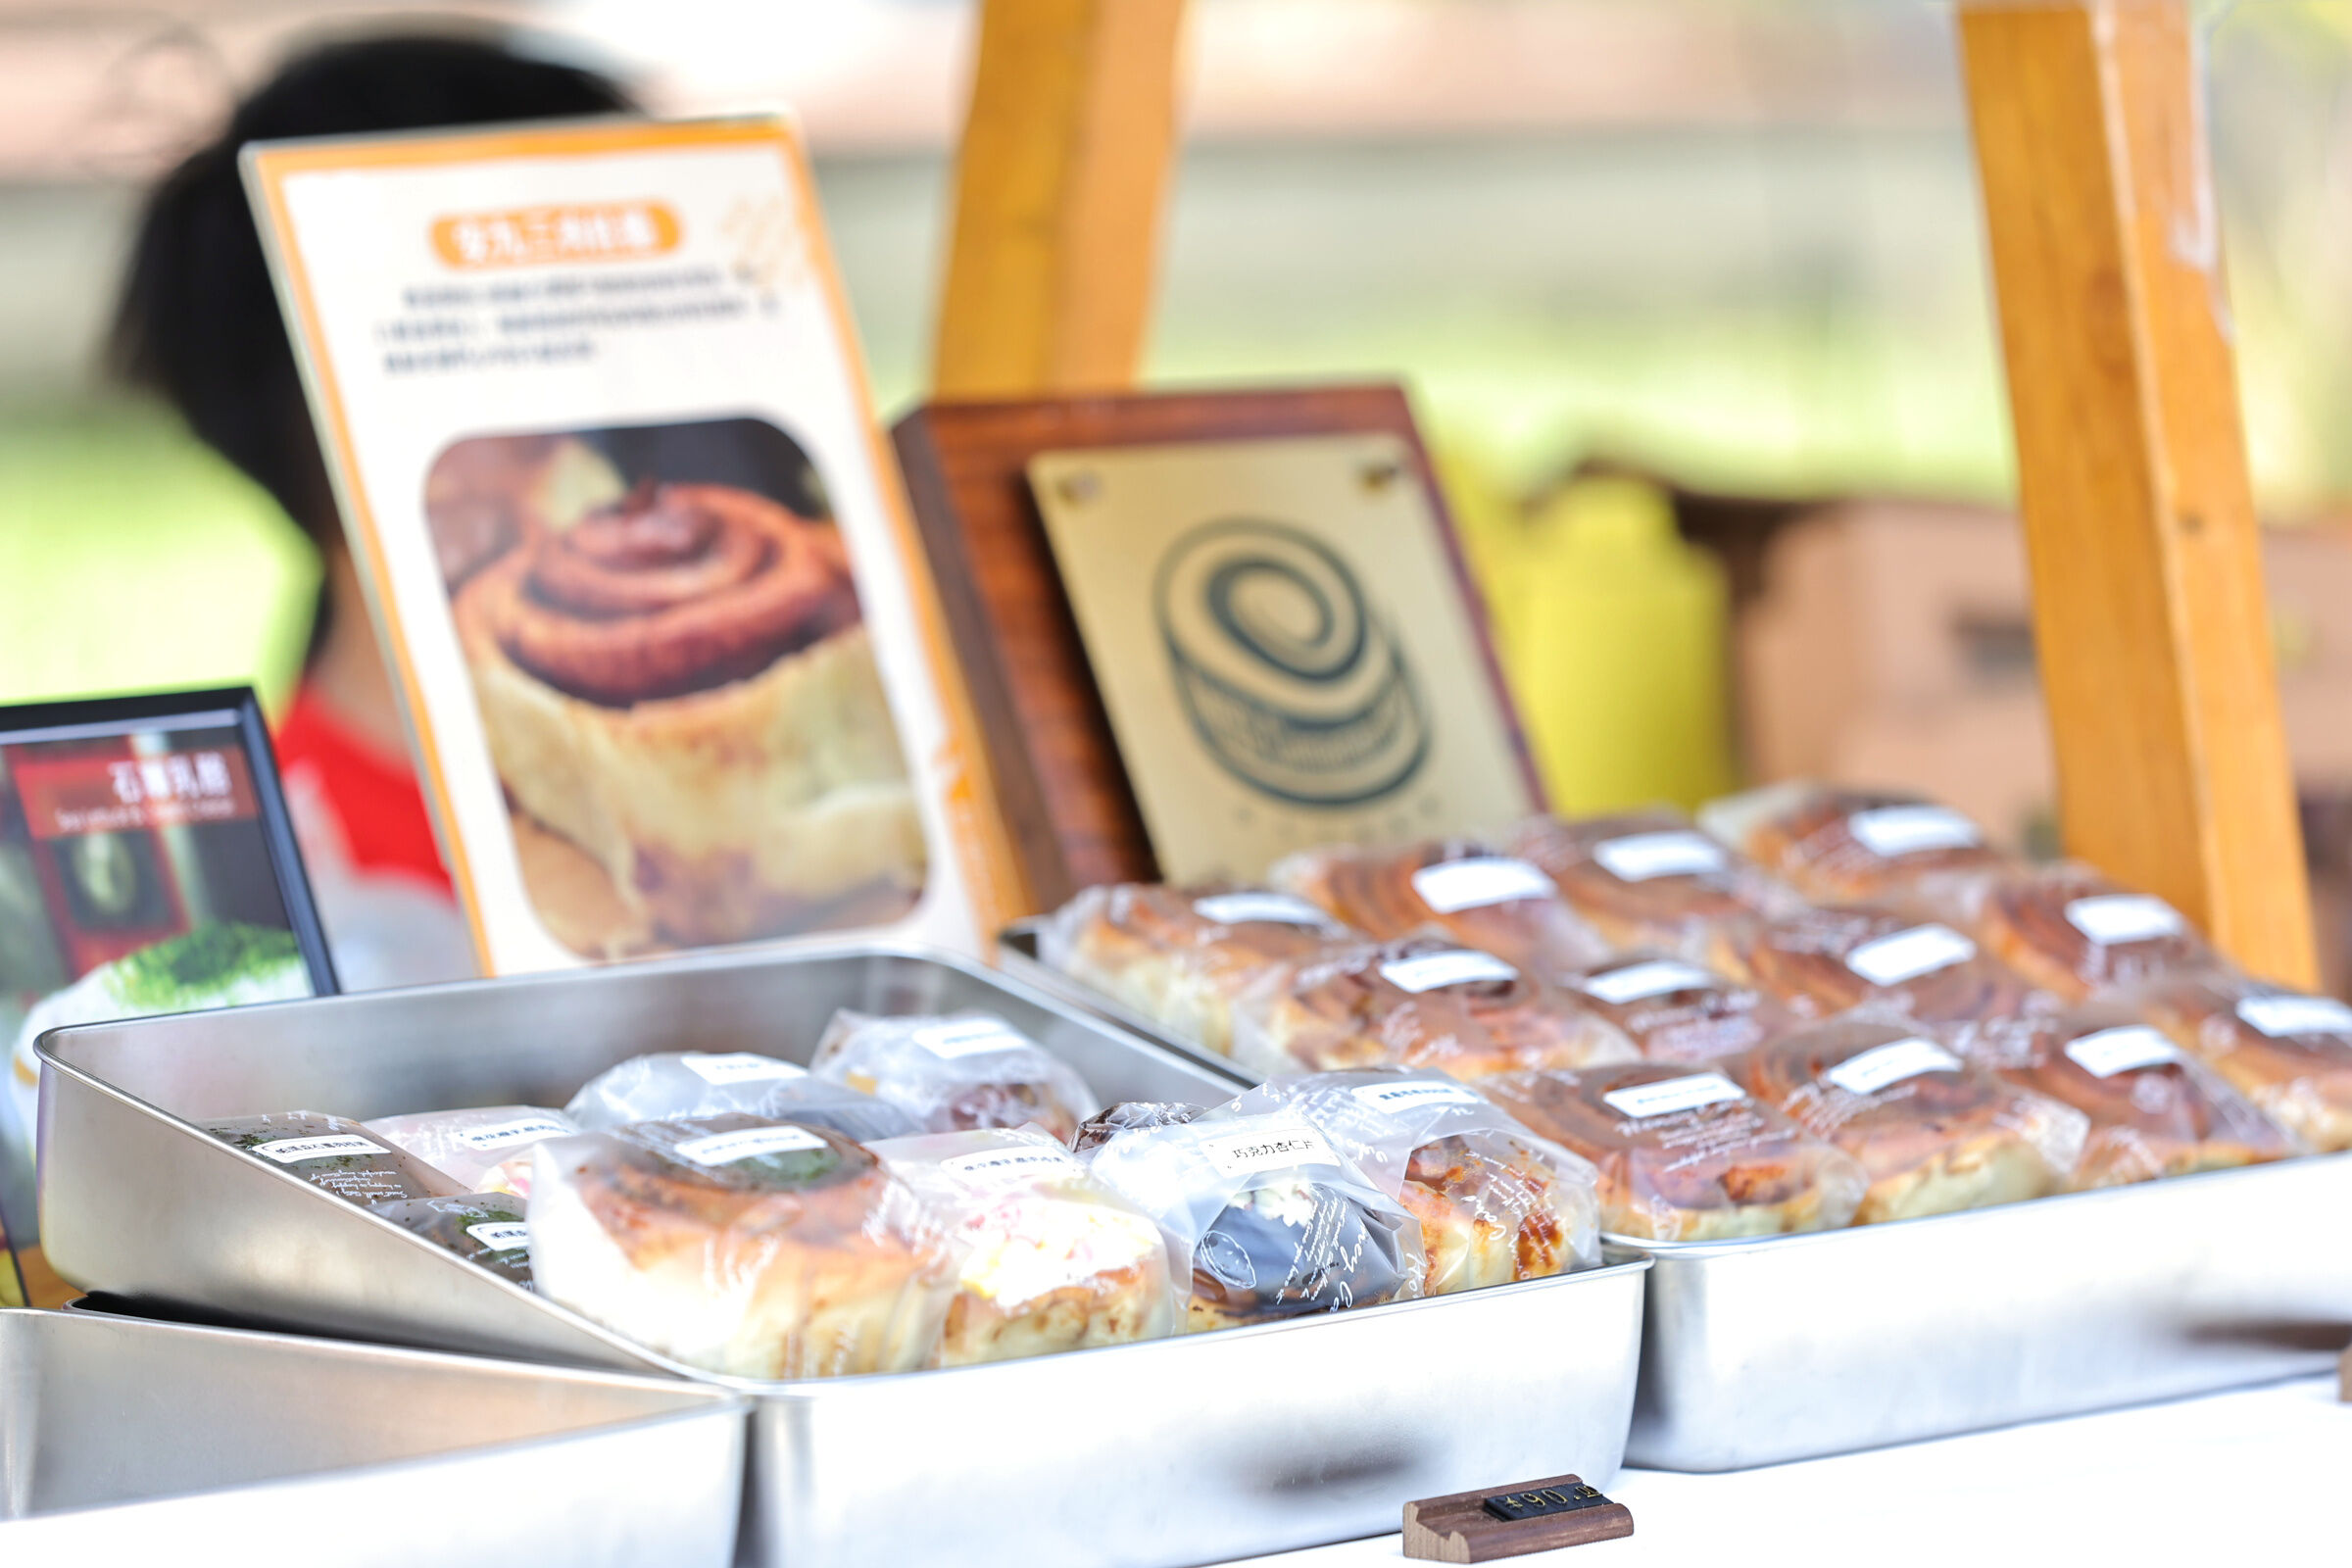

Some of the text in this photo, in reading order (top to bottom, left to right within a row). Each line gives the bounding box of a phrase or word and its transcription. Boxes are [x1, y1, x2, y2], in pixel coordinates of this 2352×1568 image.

[1233, 1139, 1314, 1158] 巧克力杏仁片
